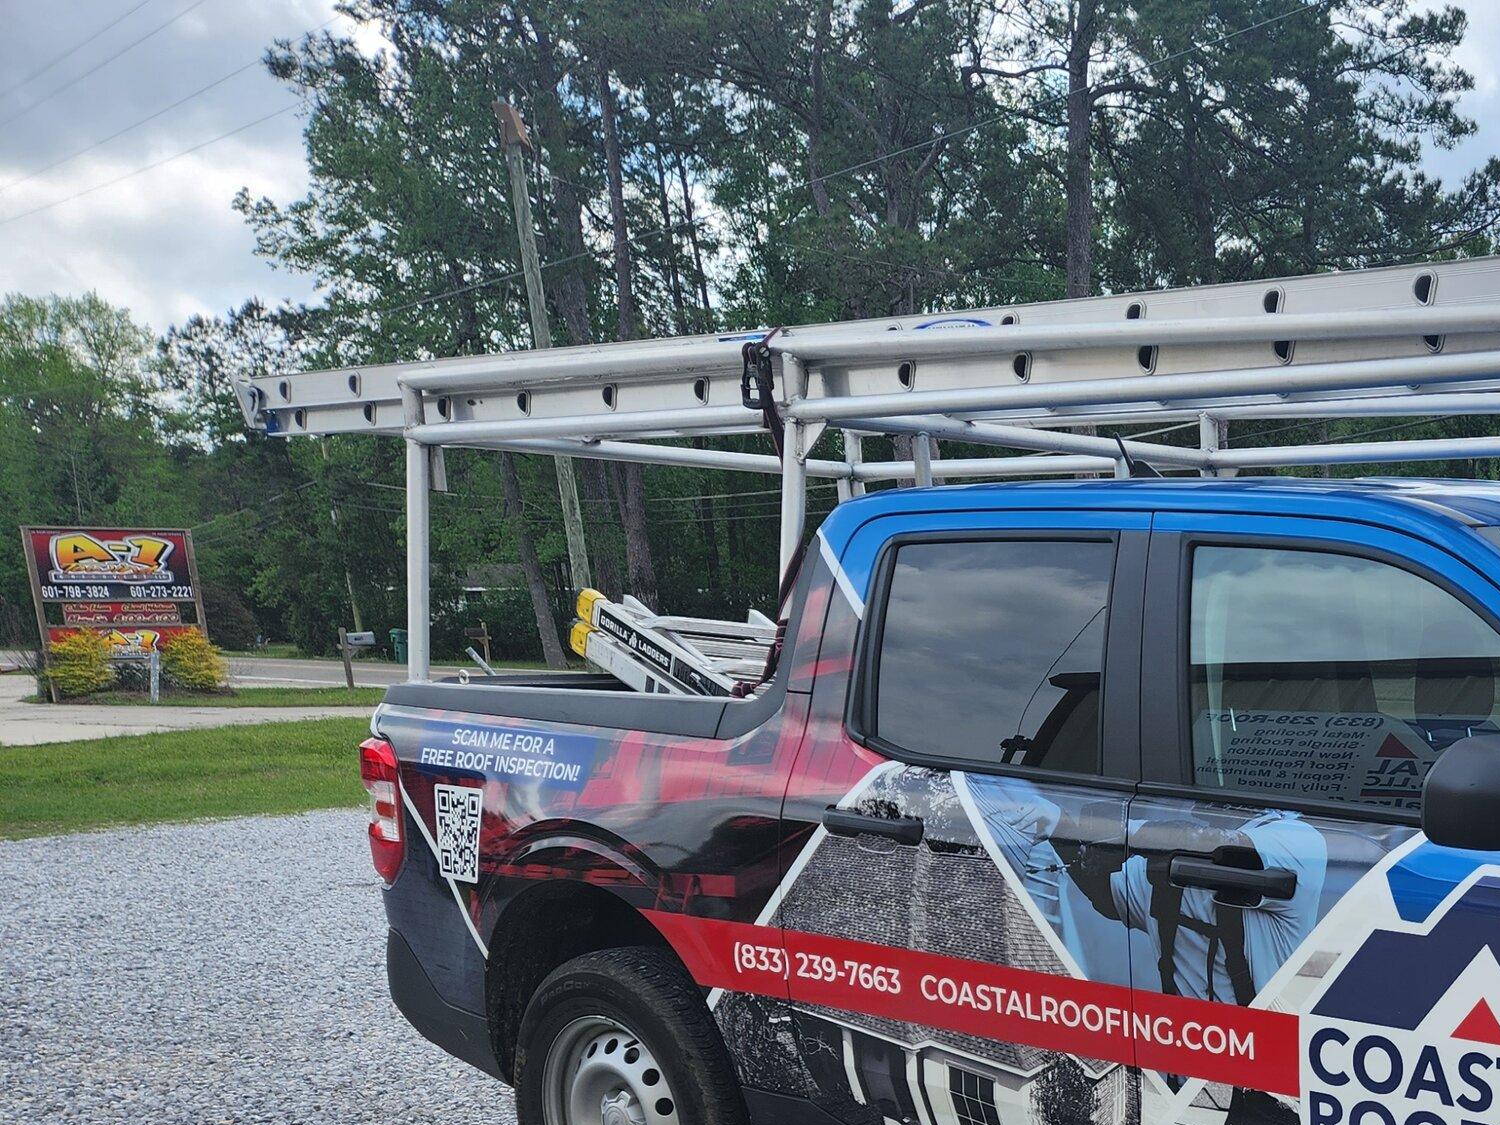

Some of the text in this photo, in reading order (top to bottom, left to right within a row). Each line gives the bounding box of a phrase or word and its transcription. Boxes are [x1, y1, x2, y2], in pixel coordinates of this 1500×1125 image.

[54, 533, 171, 569] A-1
[42, 585, 110, 598] 601-798-3824
[130, 585, 193, 598] 601-273-2221
[600, 615, 669, 667] GORILLA LADDERS
[452, 728, 555, 756] SCAN ME FOR A
[420, 747, 581, 782] FREE ROOF INSPECTION!
[733, 941, 1256, 1061] (833) 239-7663 COASTALROOFING.COM
